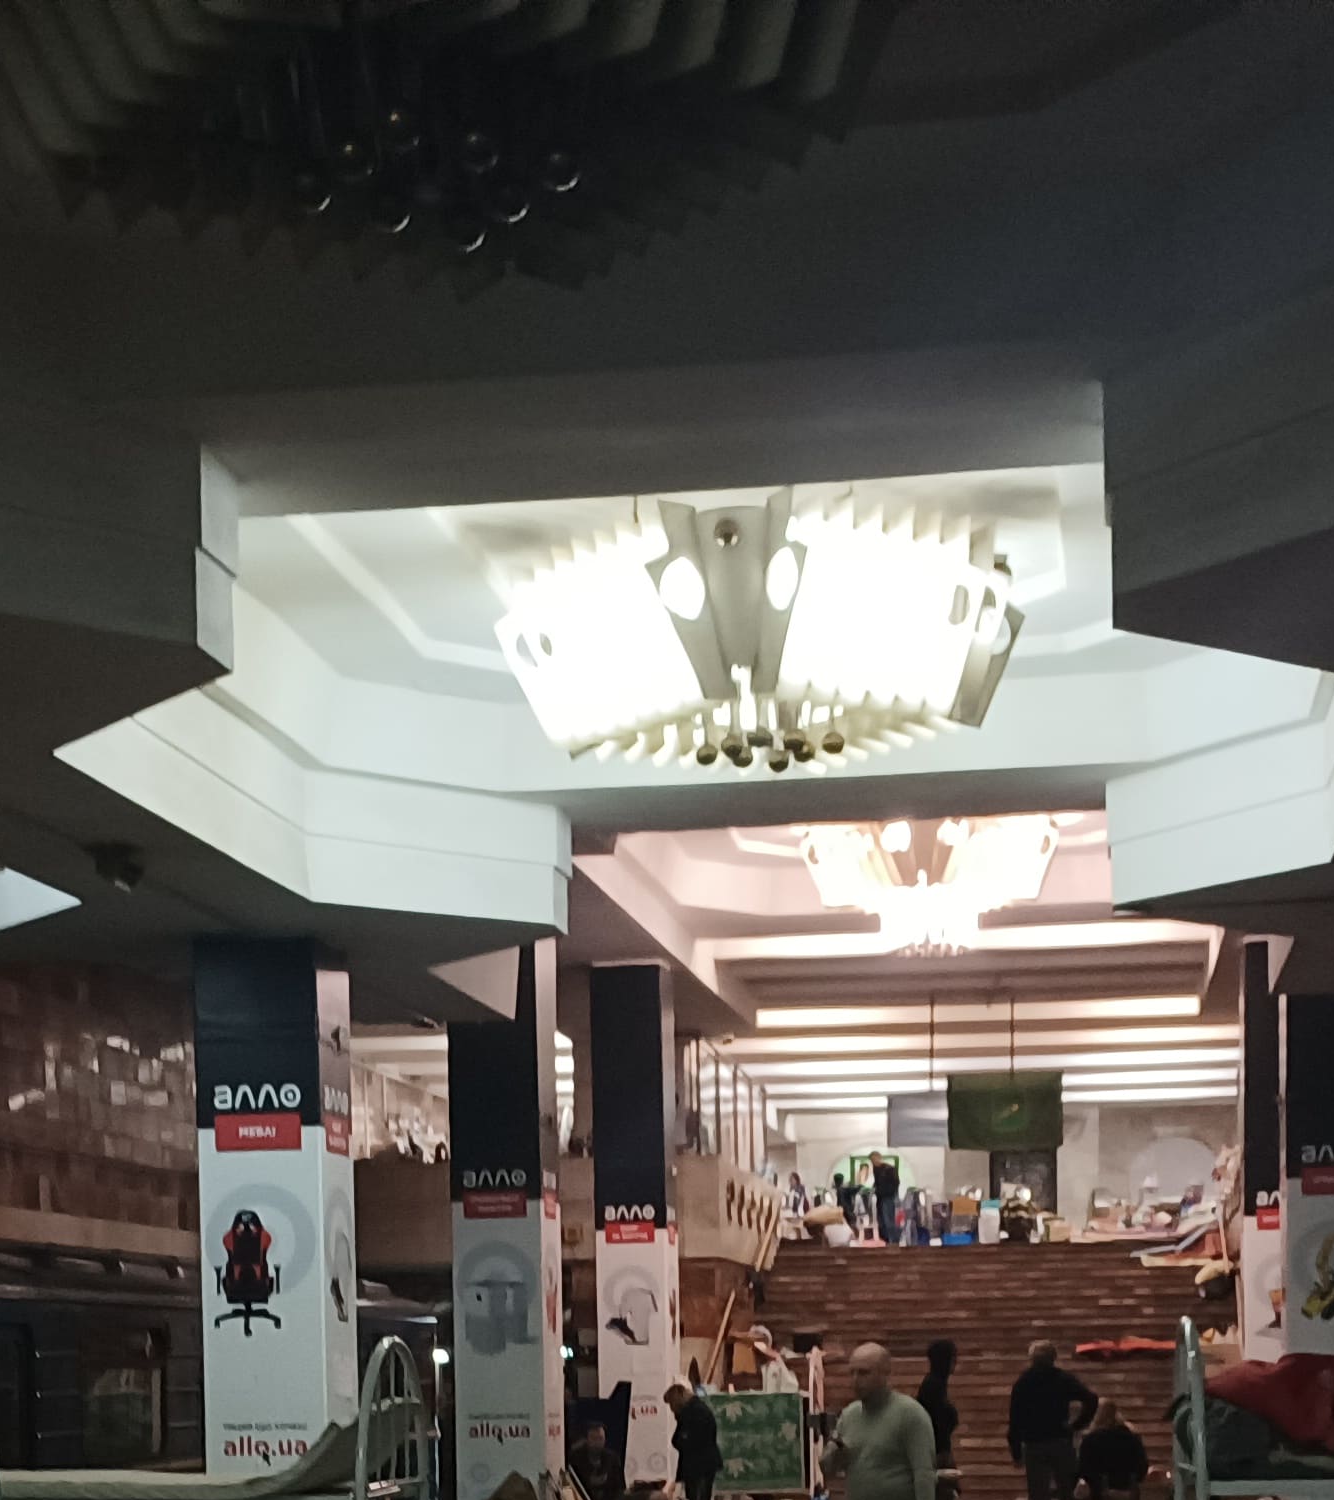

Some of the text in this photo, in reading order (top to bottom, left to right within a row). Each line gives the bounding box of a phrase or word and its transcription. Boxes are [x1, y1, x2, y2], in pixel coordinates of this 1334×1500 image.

[214, 1083, 302, 1110] алло
[469, 1421, 531, 1439] allo.ua
[224, 1435, 308, 1457] allo.ua
